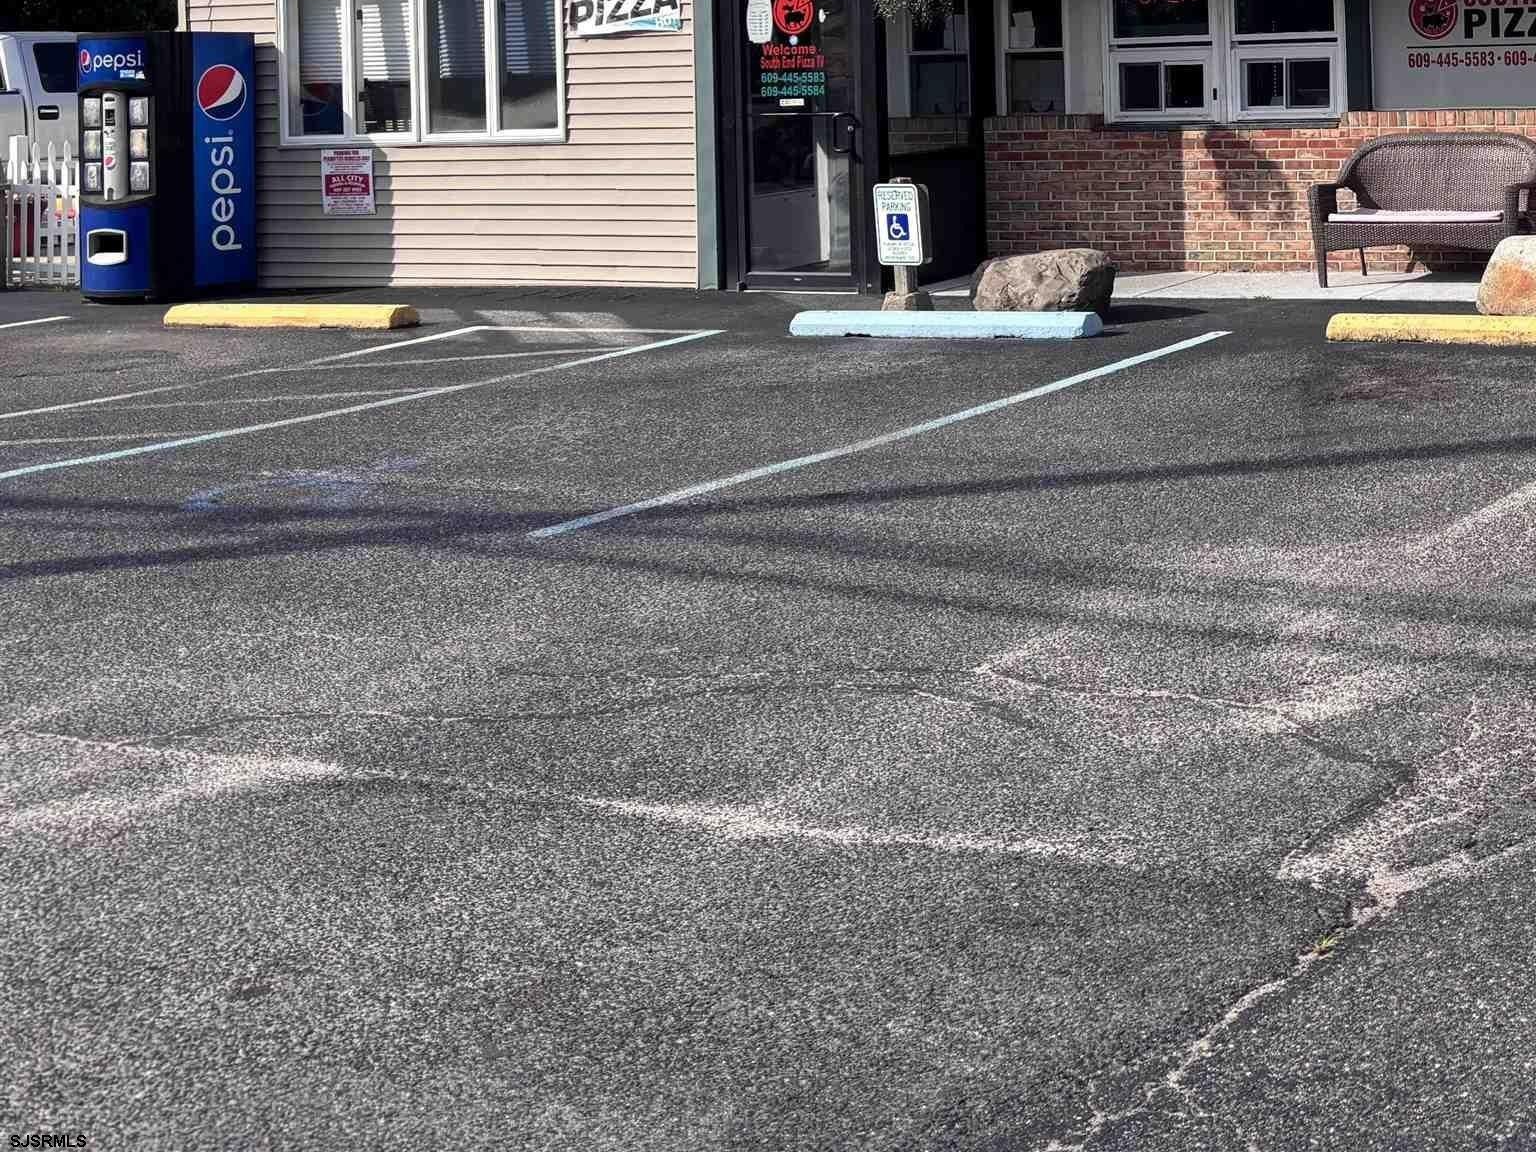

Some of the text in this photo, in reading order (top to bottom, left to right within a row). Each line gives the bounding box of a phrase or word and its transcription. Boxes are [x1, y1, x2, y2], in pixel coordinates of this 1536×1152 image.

[762, 43, 817, 56] Welcome
[93, 49, 144, 72] pepsi
[760, 56, 780, 70] South
[782, 56, 796, 69] End
[797, 55, 816, 68] Pizza
[1407, 51, 1496, 68] 609-445-5583
[761, 71, 825, 84] 609-445-5583
[761, 86, 825, 97] 609-445-5584
[205, 135, 242, 251] pepsi
[877, 190, 914, 201] RESERVED
